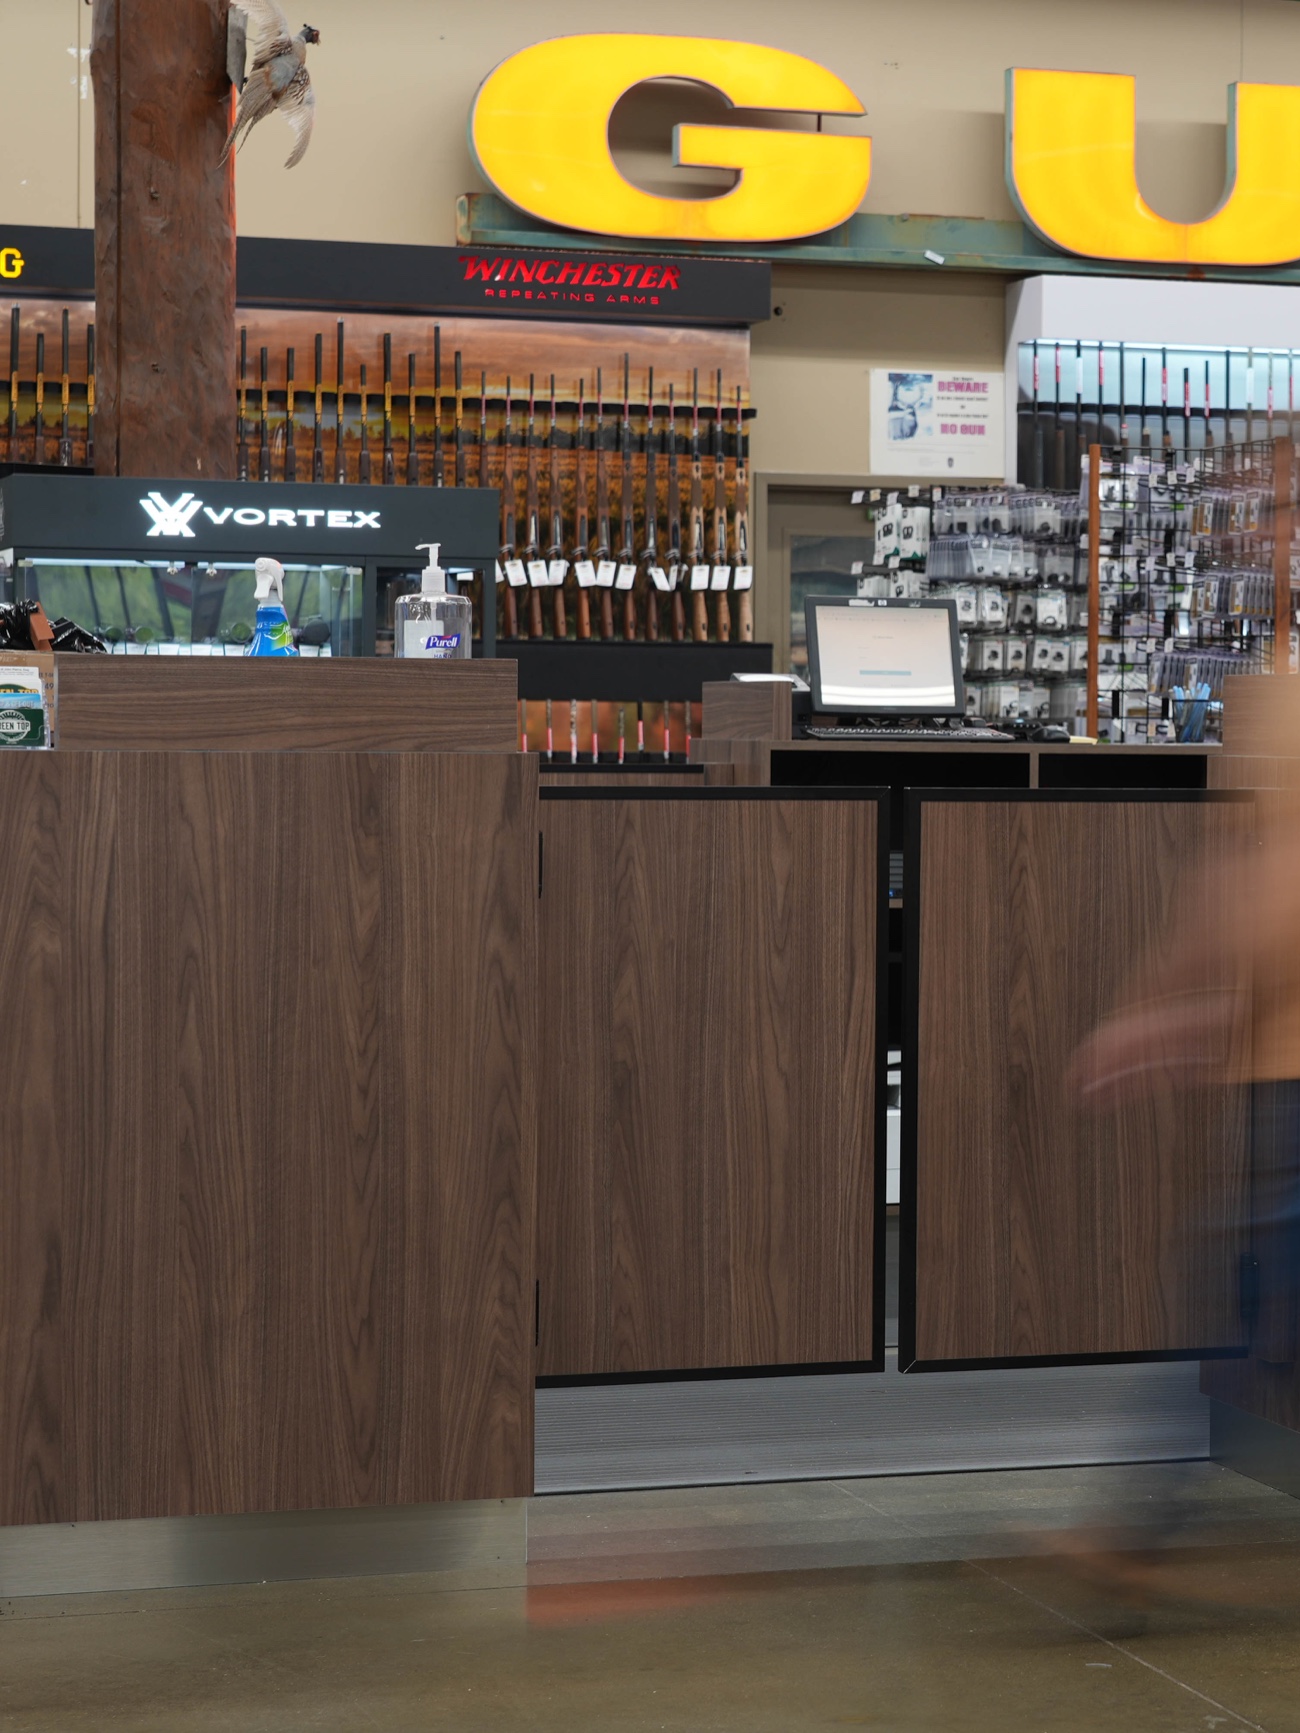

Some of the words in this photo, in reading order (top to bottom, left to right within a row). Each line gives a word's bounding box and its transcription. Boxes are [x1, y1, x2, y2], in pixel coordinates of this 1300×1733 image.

[458, 255, 682, 291] WINCHESTER
[484, 288, 595, 302] REPEATING
[606, 294, 660, 305] ARMS
[937, 381, 989, 393] BEWARE
[940, 423, 958, 435] NO
[203, 507, 382, 529] VORTEX
[429, 635, 458, 648] Purell
